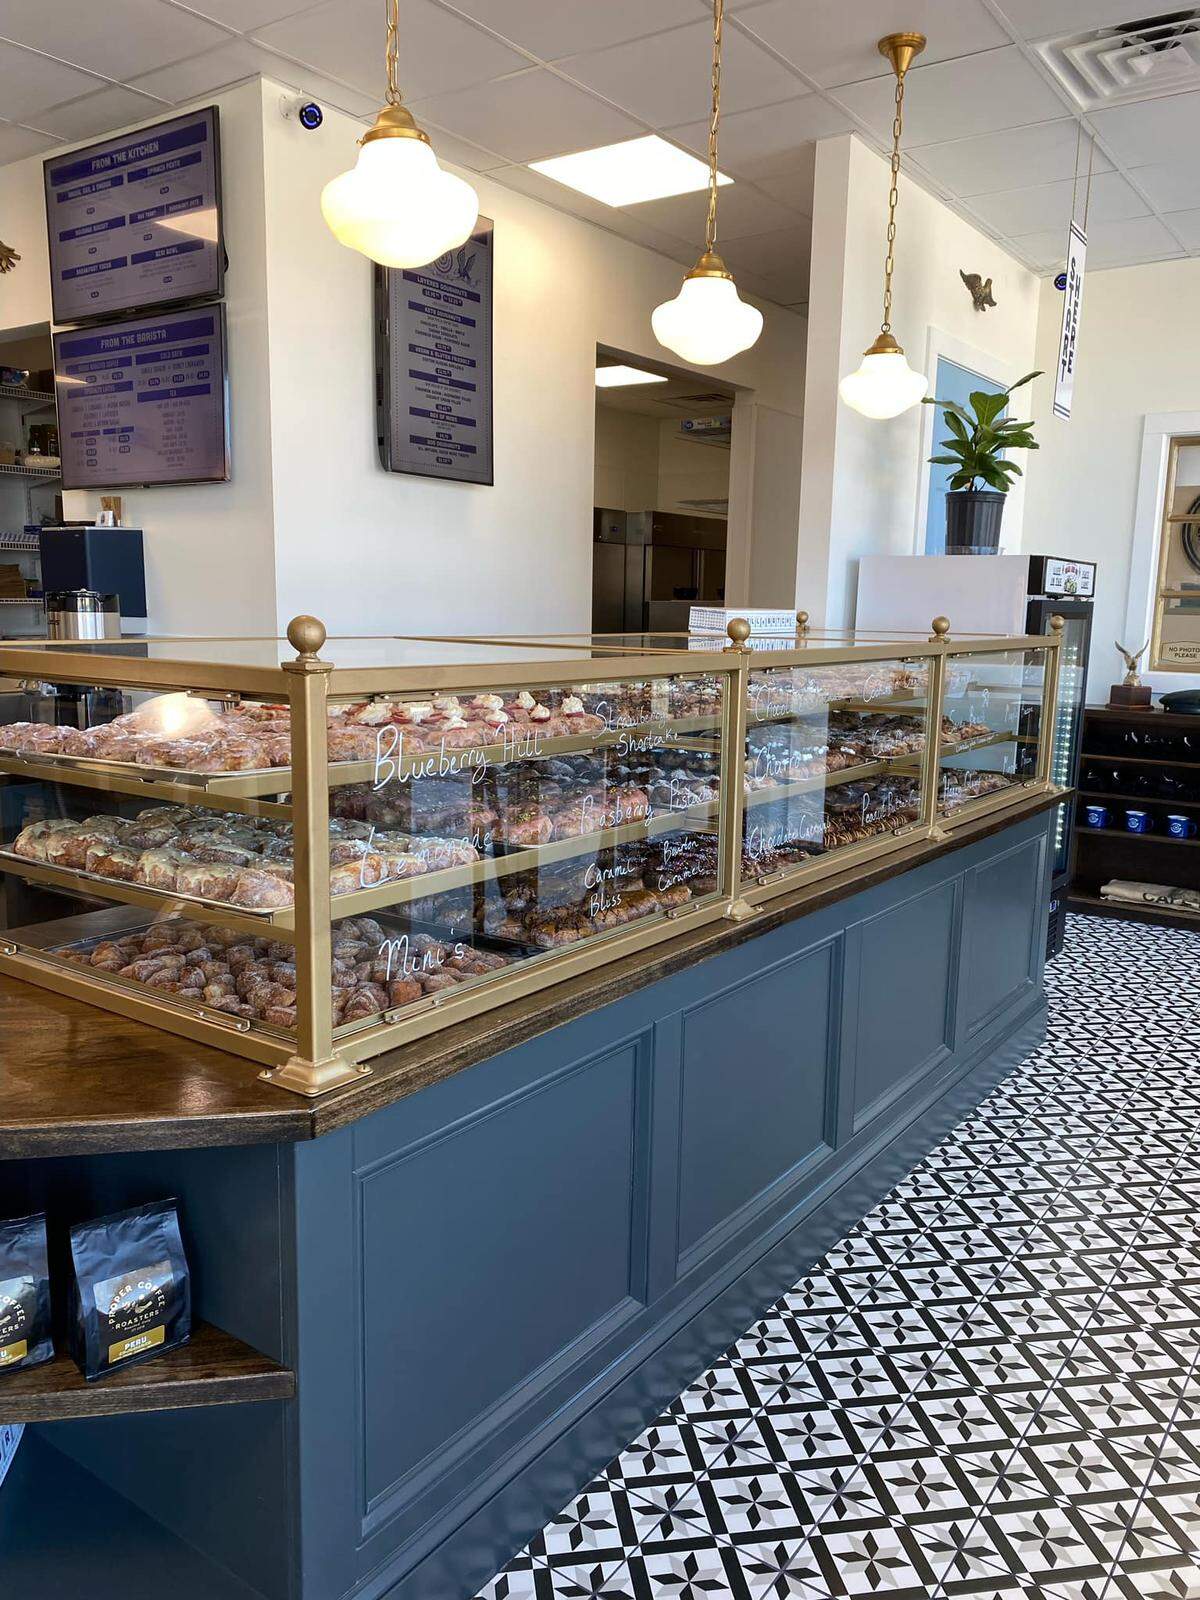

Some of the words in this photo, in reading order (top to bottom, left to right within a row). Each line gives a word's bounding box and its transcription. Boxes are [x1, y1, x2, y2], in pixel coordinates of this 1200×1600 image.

[91, 156, 112, 171] FROM
[113, 151, 127, 163] THE
[128, 141, 160, 159] KITCHEN
[100, 336, 120, 349] FROM
[122, 333, 136, 345] THE
[137, 329, 167, 343] BARISTA
[373, 724, 491, 791] Blueberry
[493, 723, 543, 763] Hill
[360, 826, 493, 888] Lemonade
[584, 860, 635, 889] Caramel
[590, 893, 622, 918] Bliss
[109, 1285, 133, 1325] PROPER
[138, 1281, 165, 1307] COFFEE
[115, 1309, 160, 1330] ROASTERS
[124, 1336, 147, 1350] PERU
